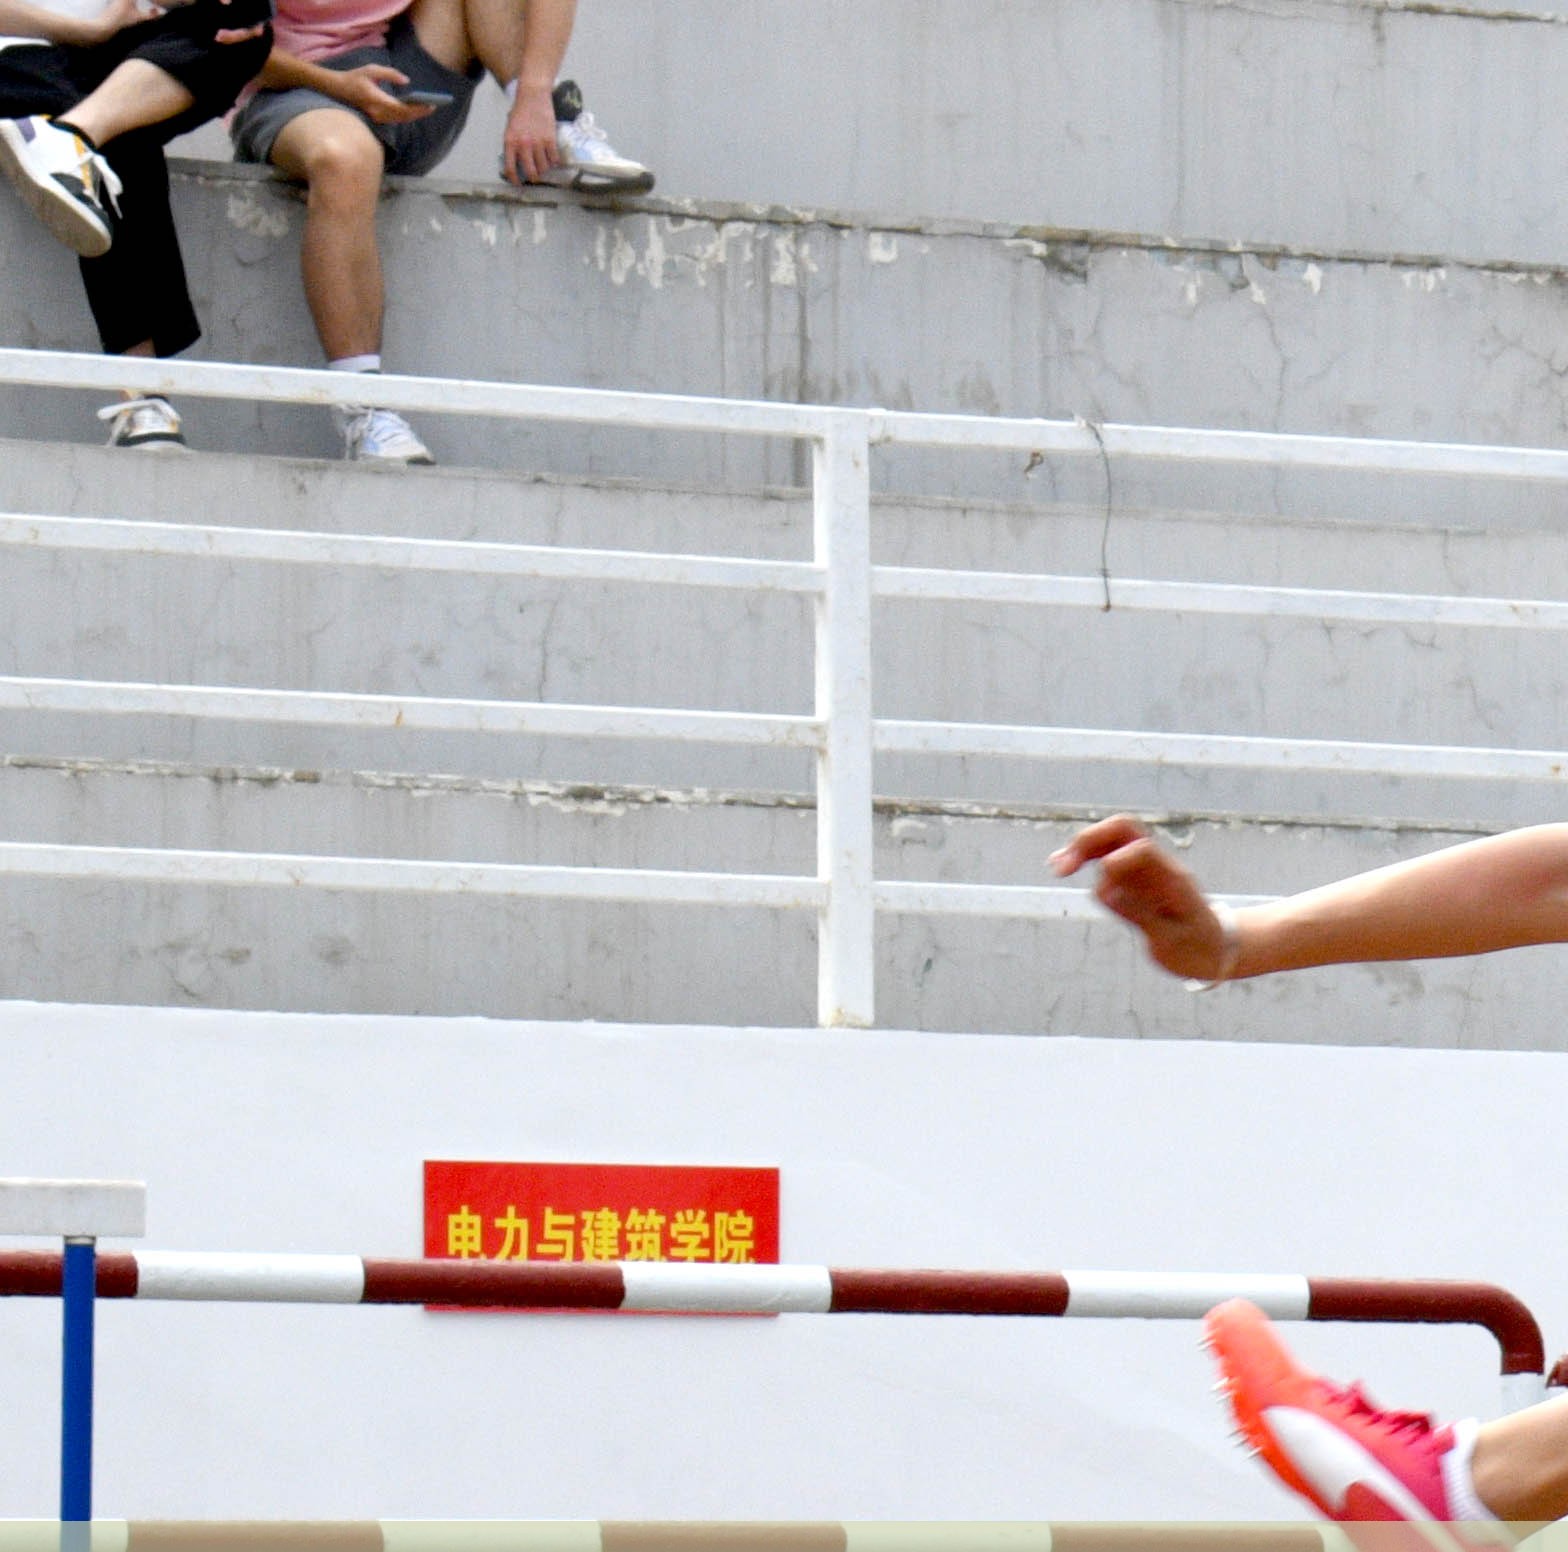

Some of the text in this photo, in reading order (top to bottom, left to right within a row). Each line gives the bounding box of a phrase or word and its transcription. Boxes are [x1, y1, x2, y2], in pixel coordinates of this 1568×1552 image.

[447, 1205, 756, 1263] 电力与建筑学院
